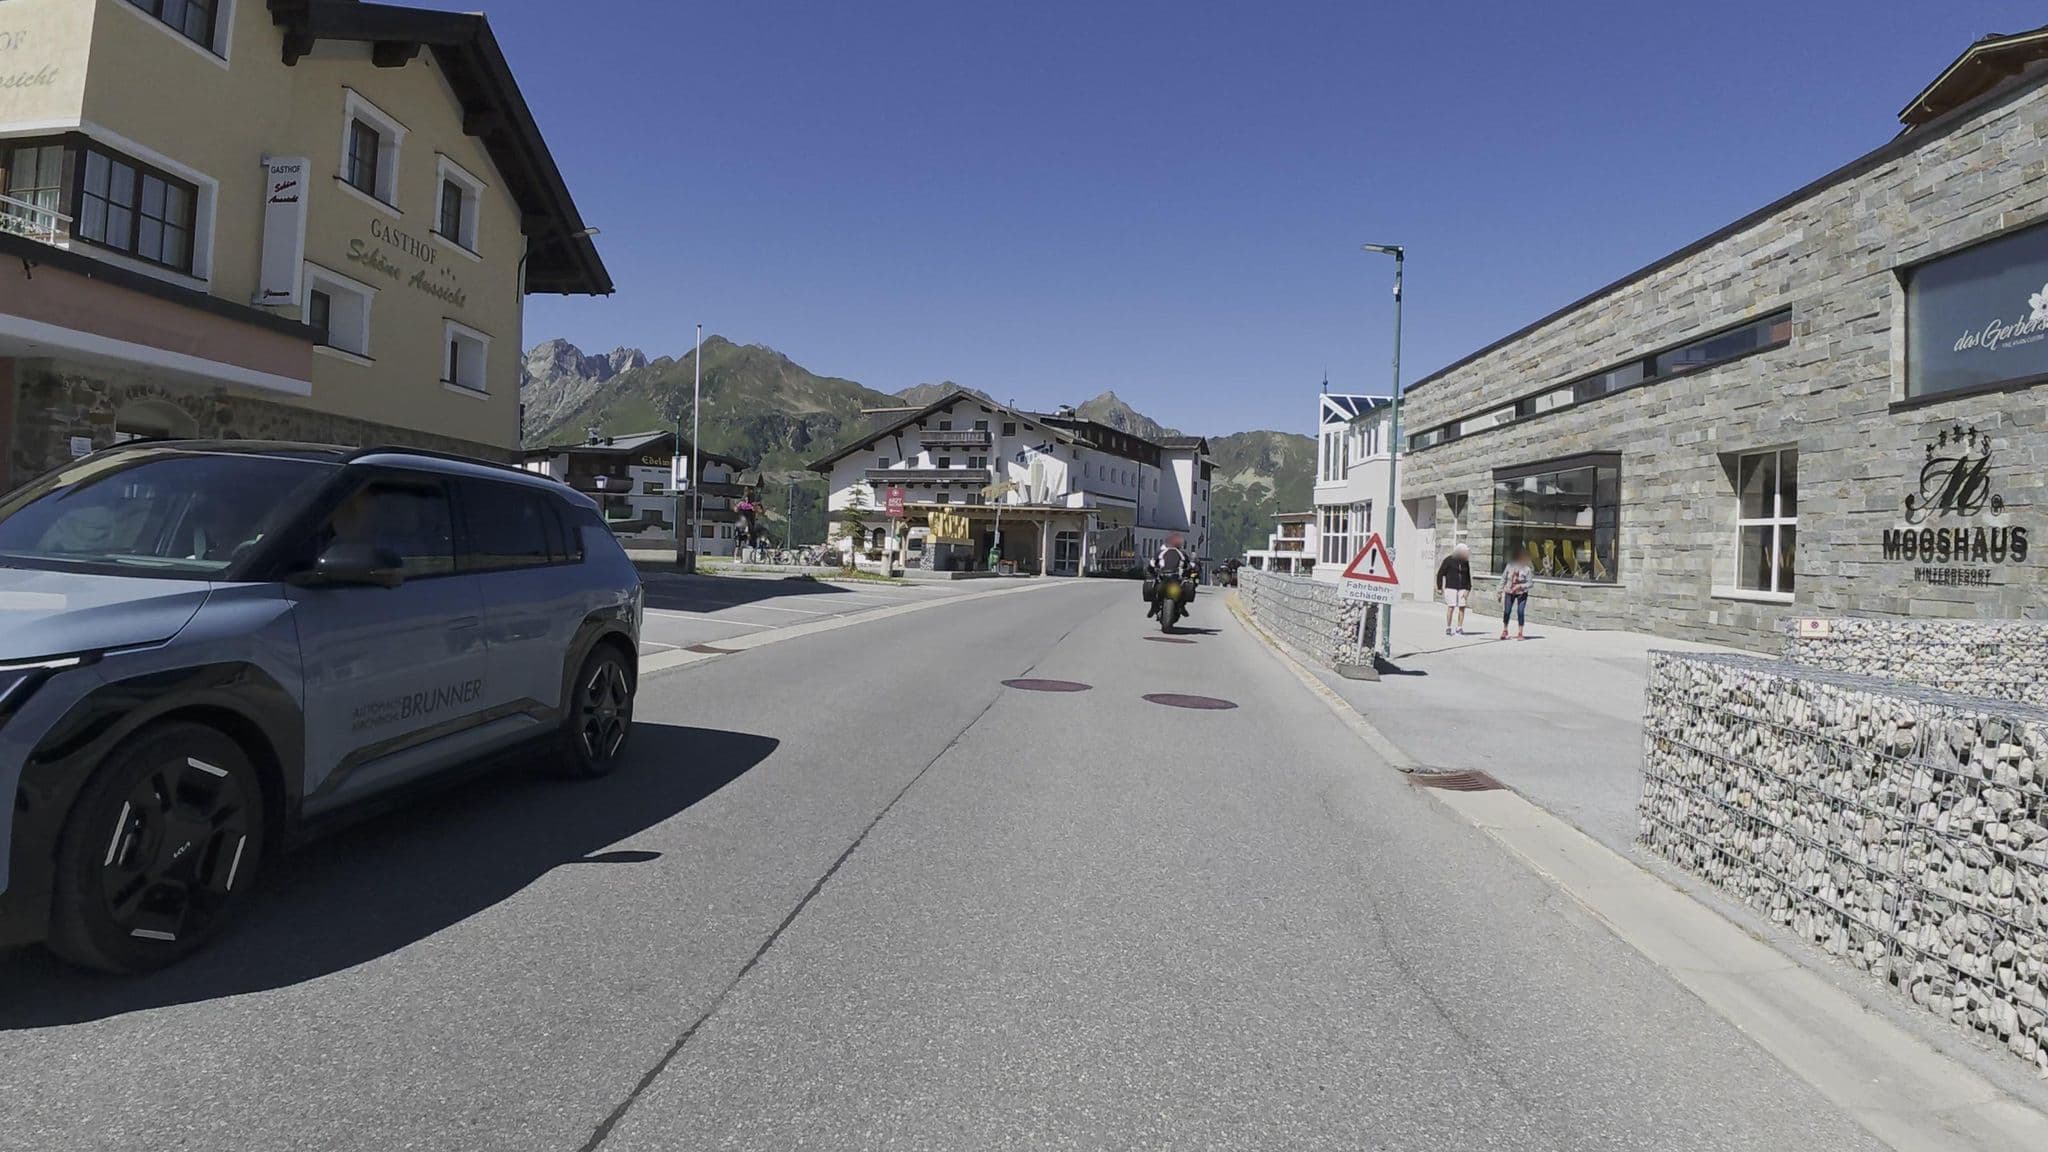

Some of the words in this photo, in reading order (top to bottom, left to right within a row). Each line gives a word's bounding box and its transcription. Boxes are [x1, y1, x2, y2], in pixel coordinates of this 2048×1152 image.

[271, 165, 301, 174] GASTHOF
[371, 218, 438, 265] GASTHOF
[346, 238, 401, 281] Schöne
[407, 270, 467, 308] Aussicht
[1954, 329, 1981, 352] das
[1883, 526, 2029, 563] MOOSHAUS
[1346, 580, 1392, 593] Fahrbahn-
[1914, 567, 1992, 586] WINTERRESORT
[1349, 590, 1388, 601] schäden
[400, 679, 482, 719] BRUNNER
